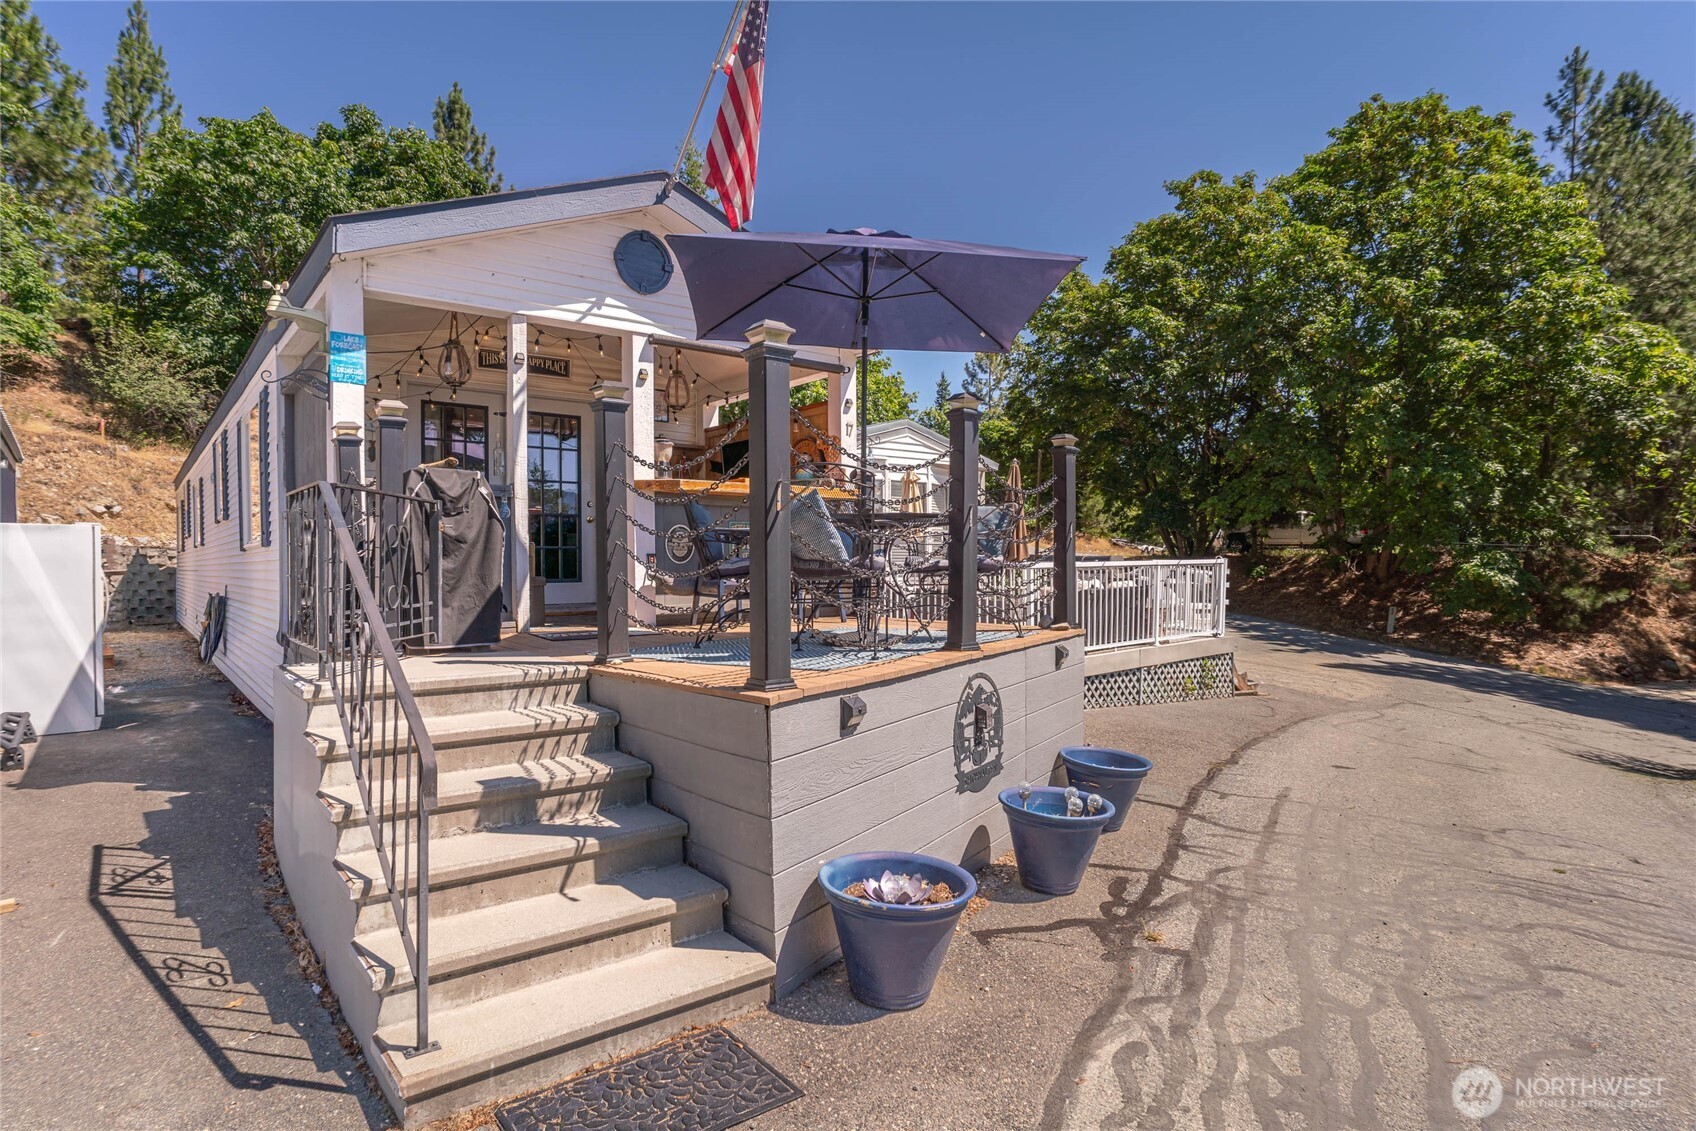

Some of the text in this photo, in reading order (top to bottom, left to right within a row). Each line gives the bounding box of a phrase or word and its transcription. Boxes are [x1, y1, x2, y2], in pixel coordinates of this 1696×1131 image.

[331, 340, 364, 351] FORECAST
[481, 351, 499, 365] THIS
[528, 357, 545, 369] APPY
[545, 360, 566, 375] PLACE
[845, 422, 854, 438] 17
